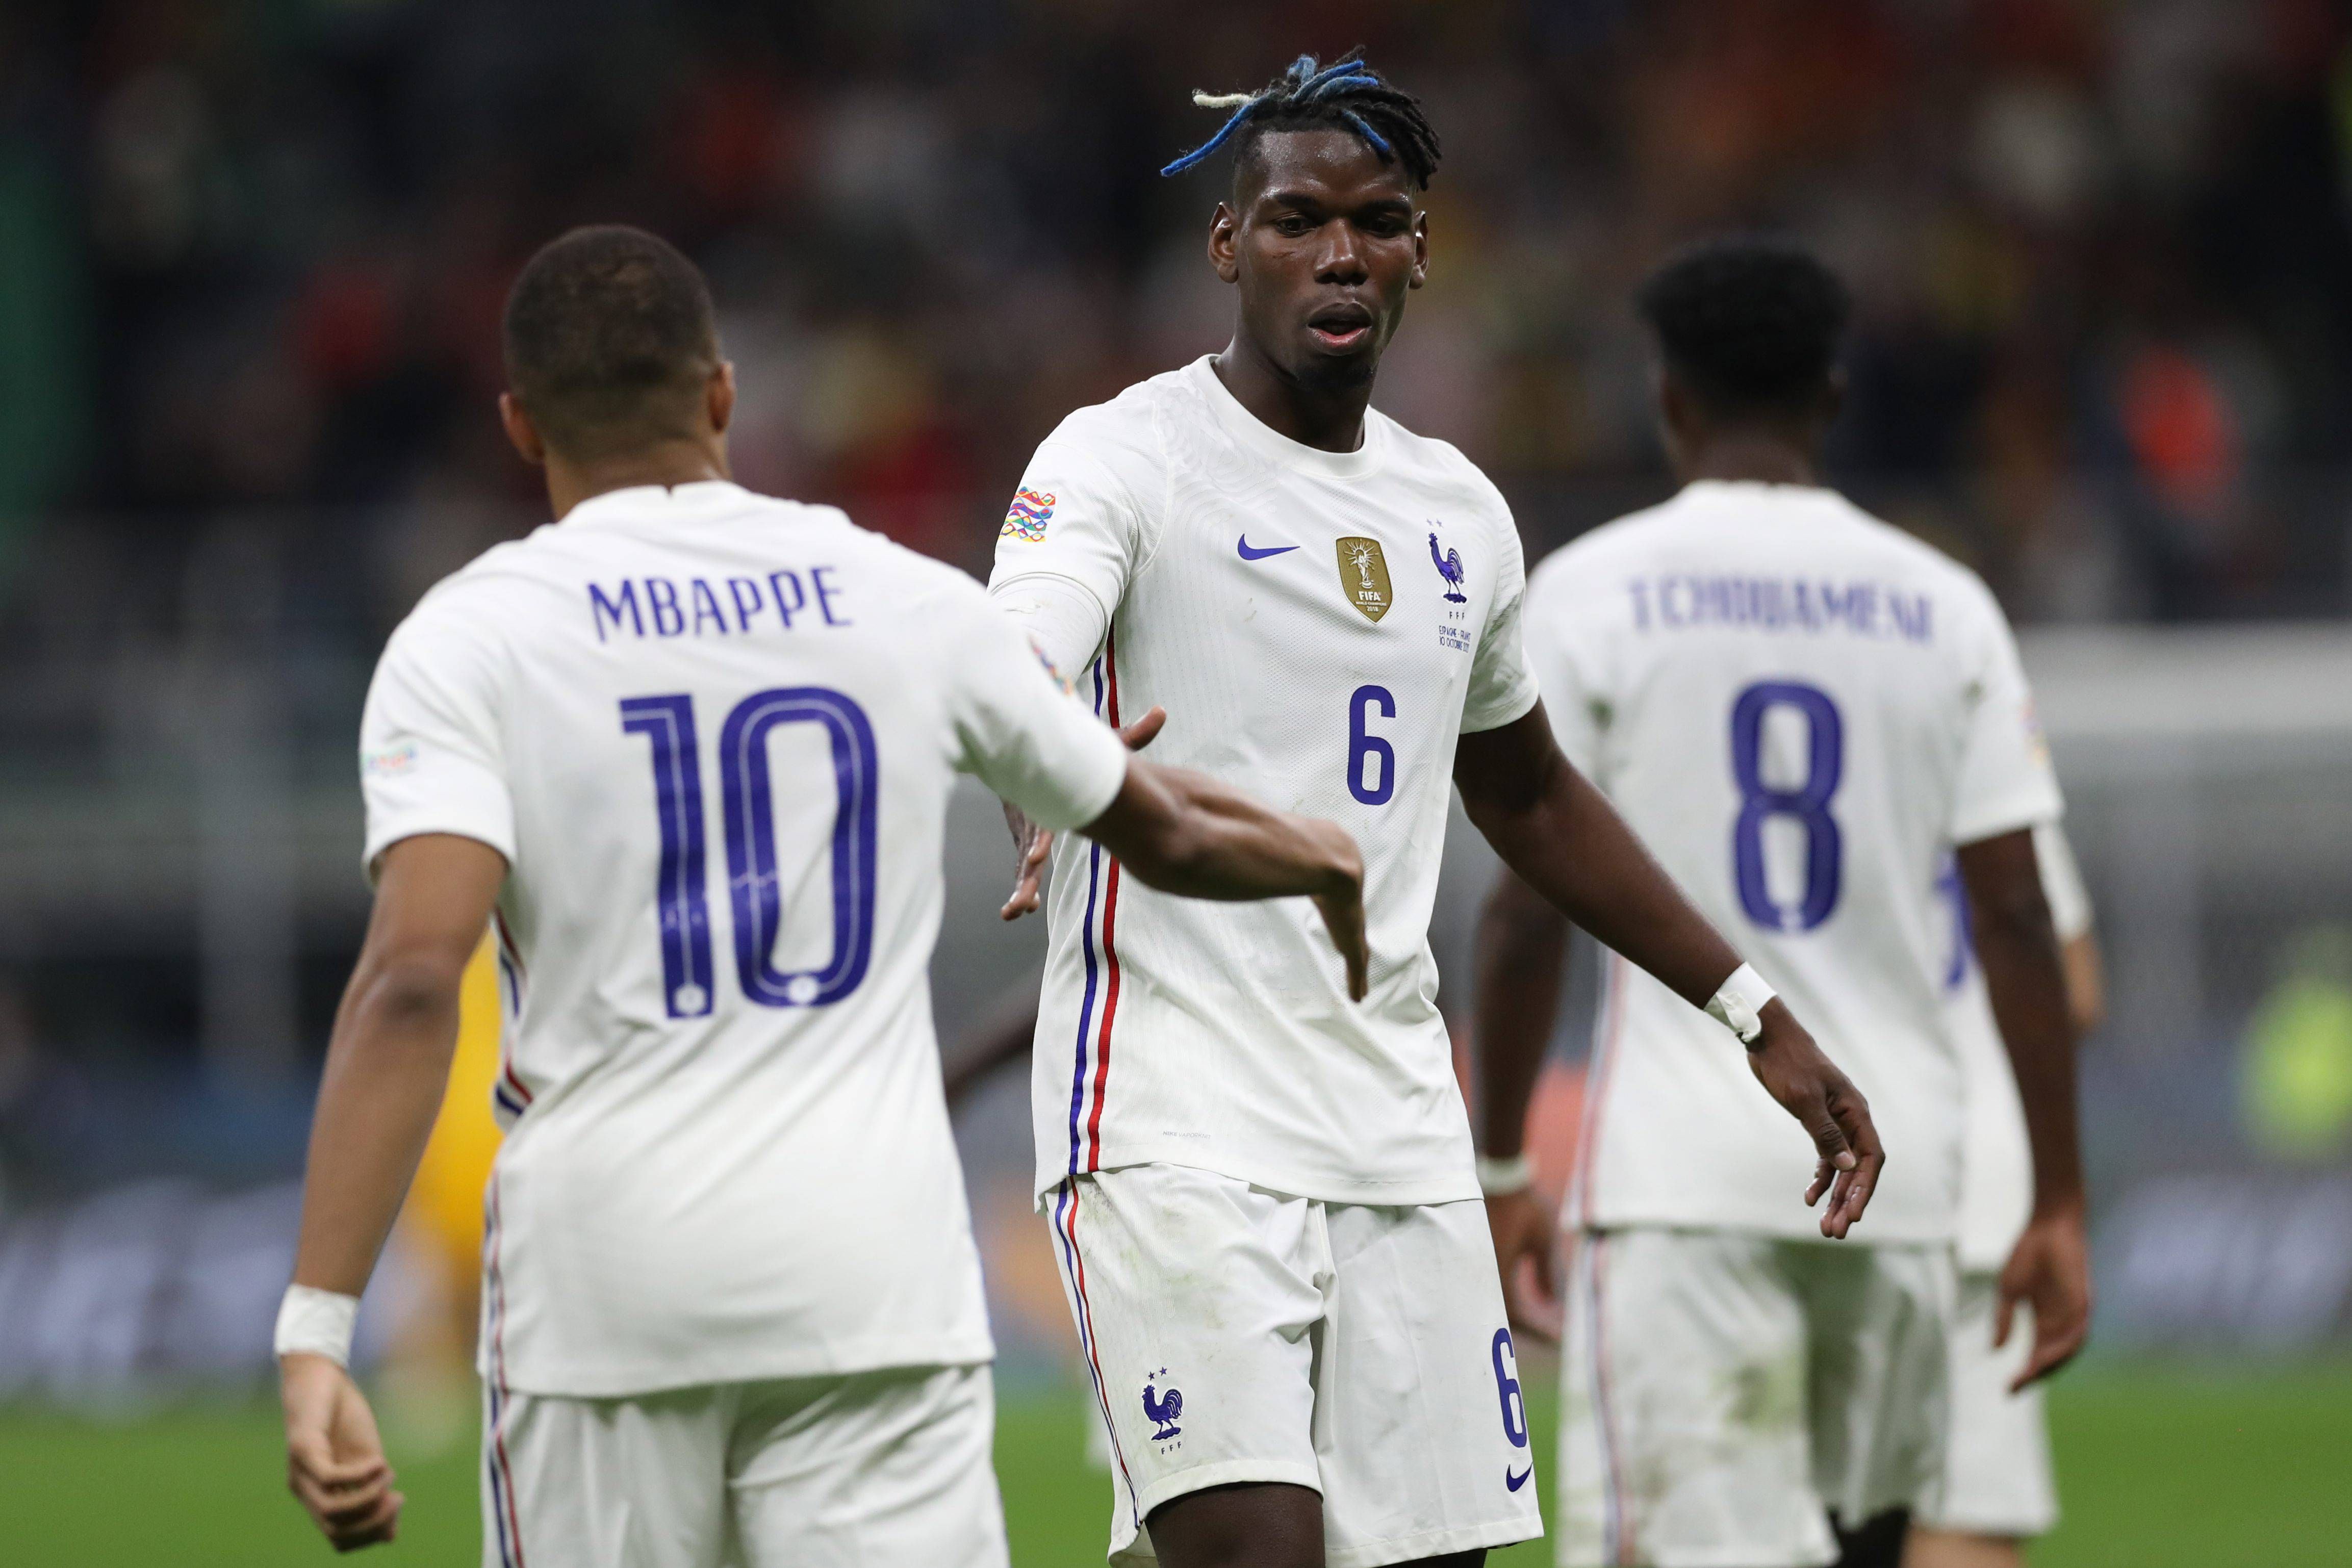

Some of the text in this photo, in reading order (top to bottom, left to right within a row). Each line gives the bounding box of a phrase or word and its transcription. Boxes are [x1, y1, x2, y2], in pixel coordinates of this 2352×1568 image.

[586, 564, 854, 644] MBAPPE
[1358, 590, 1381, 601] FIFA
[1347, 684, 1396, 806] 6
[619, 685, 878, 1019] 10
[1729, 679, 1843, 937] 8
[1492, 1327, 1527, 1448] 6
